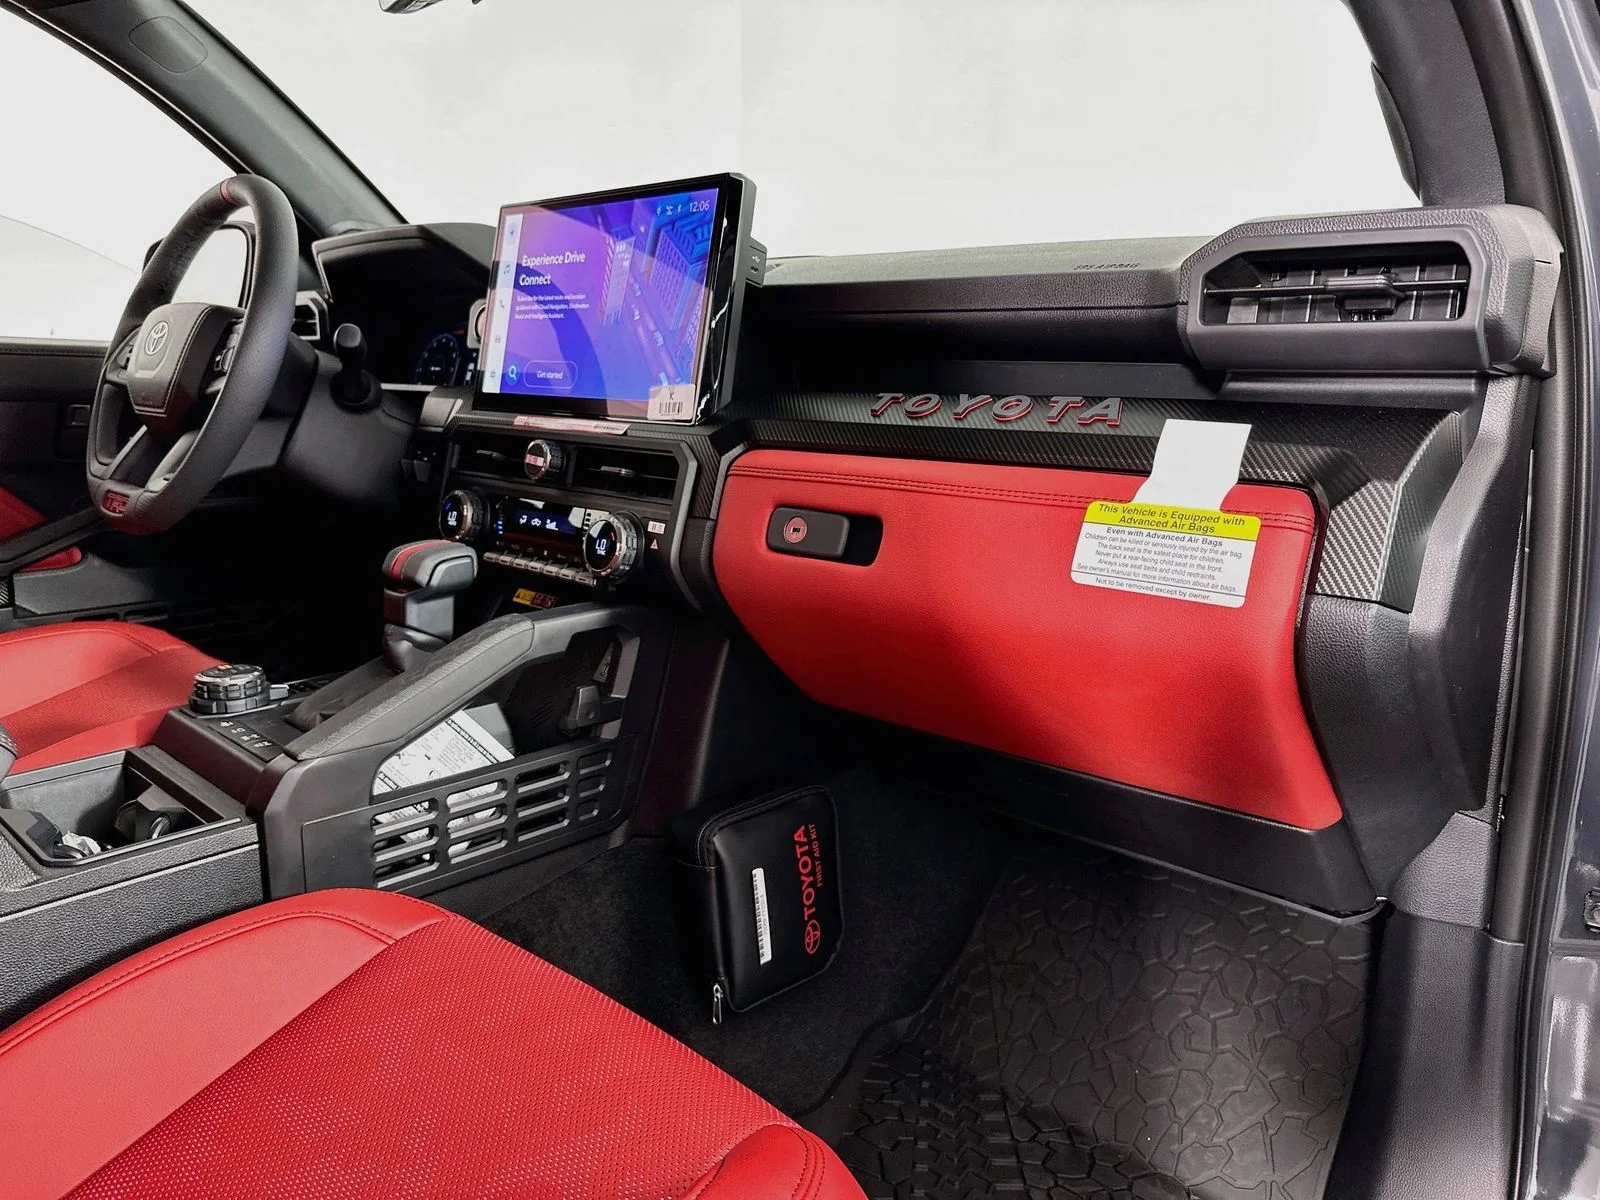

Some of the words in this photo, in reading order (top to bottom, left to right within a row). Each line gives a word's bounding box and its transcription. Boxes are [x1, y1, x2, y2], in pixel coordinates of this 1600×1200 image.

[690, 200, 710, 212] 12:06
[522, 253, 563, 269] Experience
[564, 250, 586, 264] Drive
[519, 273, 551, 287] Connect
[537, 370, 546, 379] Get
[546, 371, 564, 379] started
[871, 393, 1123, 426] TOYOTA
[1099, 503, 1119, 513] This
[1122, 506, 1157, 517] Vehicle
[1158, 509, 1168, 519] is
[1170, 510, 1221, 525] Equipped
[1223, 515, 1246, 526] with
[1119, 516, 1168, 528] Advanced
[1170, 520, 1187, 531] Air
[1188, 522, 1216, 534] Bags
[1084, 532, 1108, 541] Children
[1108, 535, 1119, 543] can
[1119, 536, 1128, 544] be
[1128, 538, 1144, 546] killed
[1151, 541, 1178, 551] seriously
[1178, 543, 1199, 553] injured
[1199, 546, 1208, 556] by
[1208, 547, 1219, 556] the
[1220, 549, 1229, 557] air
[1106, 526, 1126, 535] Even
[1127, 529, 1144, 538] with
[1145, 531, 1186, 542] Advanced
[1186, 536, 1200, 545] Air
[1201, 537, 1223, 548] Bags
[1095, 550, 1112, 558] Never
[1112, 552, 1122, 560] put
[1127, 555, 1159, 566] rear-facing
[1159, 558, 1174, 567] child
[1174, 560, 1188, 568] seat
[1196, 563, 1206, 571] the
[1207, 565, 1223, 574] front.
[1097, 541, 1108, 549] The
[1108, 543, 1122, 551] back
[1123, 545, 1136, 553] seat
[1143, 547, 1153, 555] the
[1153, 549, 1172, 558] safest
[1172, 551, 1189, 560] place
[1189, 553, 1198, 561] for
[1199, 554, 1225, 565] children.
[1077, 562, 1088, 570] See
[1088, 565, 1110, 574] owner's
[1110, 567, 1132, 577] manual
[1132, 570, 1141, 578] for
[1141, 572, 1157, 580] more
[1157, 574, 1191, 585] information
[1191, 580, 1210, 590] about
[1210, 582, 1219, 590] air
[1097, 558, 1118, 568] Always
[1118, 561, 1129, 569] use
[1143, 564, 1158, 573] belts
[1158, 567, 1170, 575] and
[1171, 568, 1186, 577] child
[1095, 577, 1107, 585] Not
[1107, 578, 1115, 586] to
[1115, 580, 1125, 588] be
[1125, 582, 1154, 592] removed
[1155, 586, 1178, 596] except
[1178, 588, 1188, 598] by
[1188, 590, 1212, 601] owner.
[808, 823, 817, 839] KIT
[811, 840, 821, 858] AID
[793, 824, 816, 921] TOYOTA
[814, 860, 824, 888] FIRST
